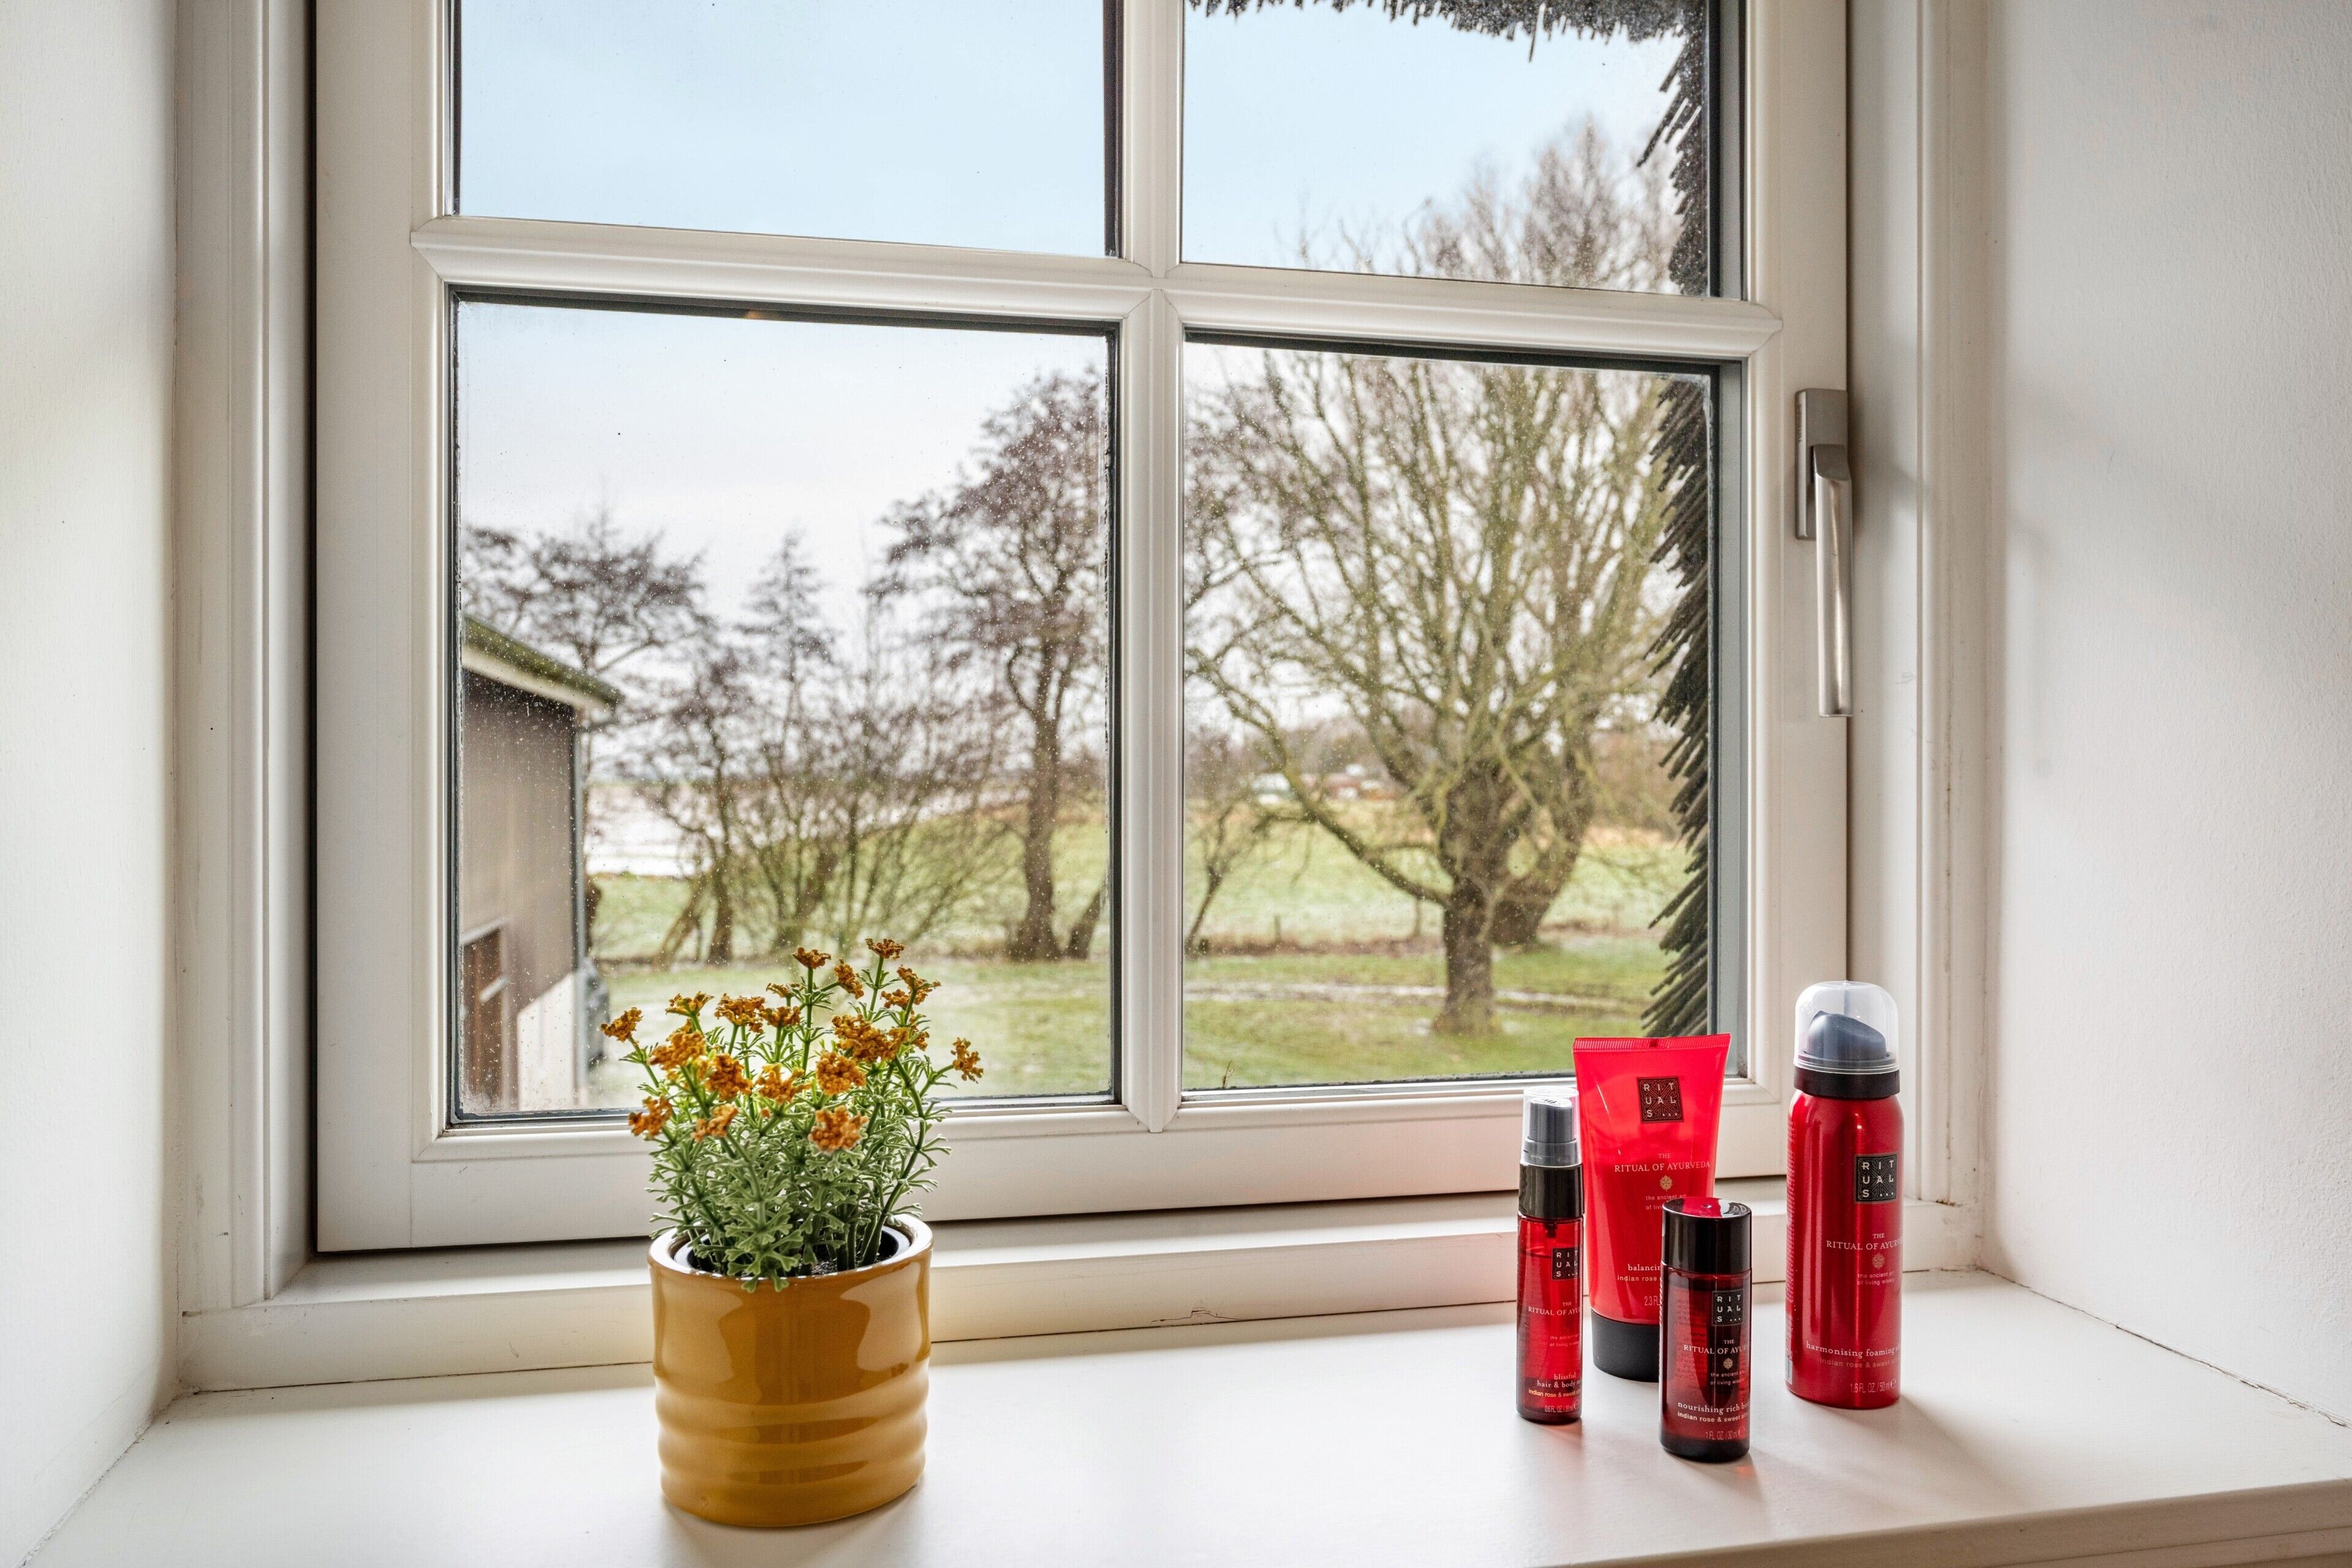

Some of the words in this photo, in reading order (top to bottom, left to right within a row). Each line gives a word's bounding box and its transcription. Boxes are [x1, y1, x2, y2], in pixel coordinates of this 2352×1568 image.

[1667, 1161, 1711, 1170] AYURVEDA
[1826, 1240, 1863, 1250] RITUAL
[1528, 1306, 1555, 1316] RITUAL
[1684, 1344, 1715, 1354] RITUAL
[1806, 1341, 1863, 1359] harmonising
[1866, 1348, 1894, 1357] foaming
[1820, 1357, 1843, 1366] indian
[1528, 1388, 1544, 1396] indian
[1678, 1402, 1724, 1415] nourishing
[1726, 1404, 1740, 1412] rich
[1678, 1411, 1698, 1421] indian
